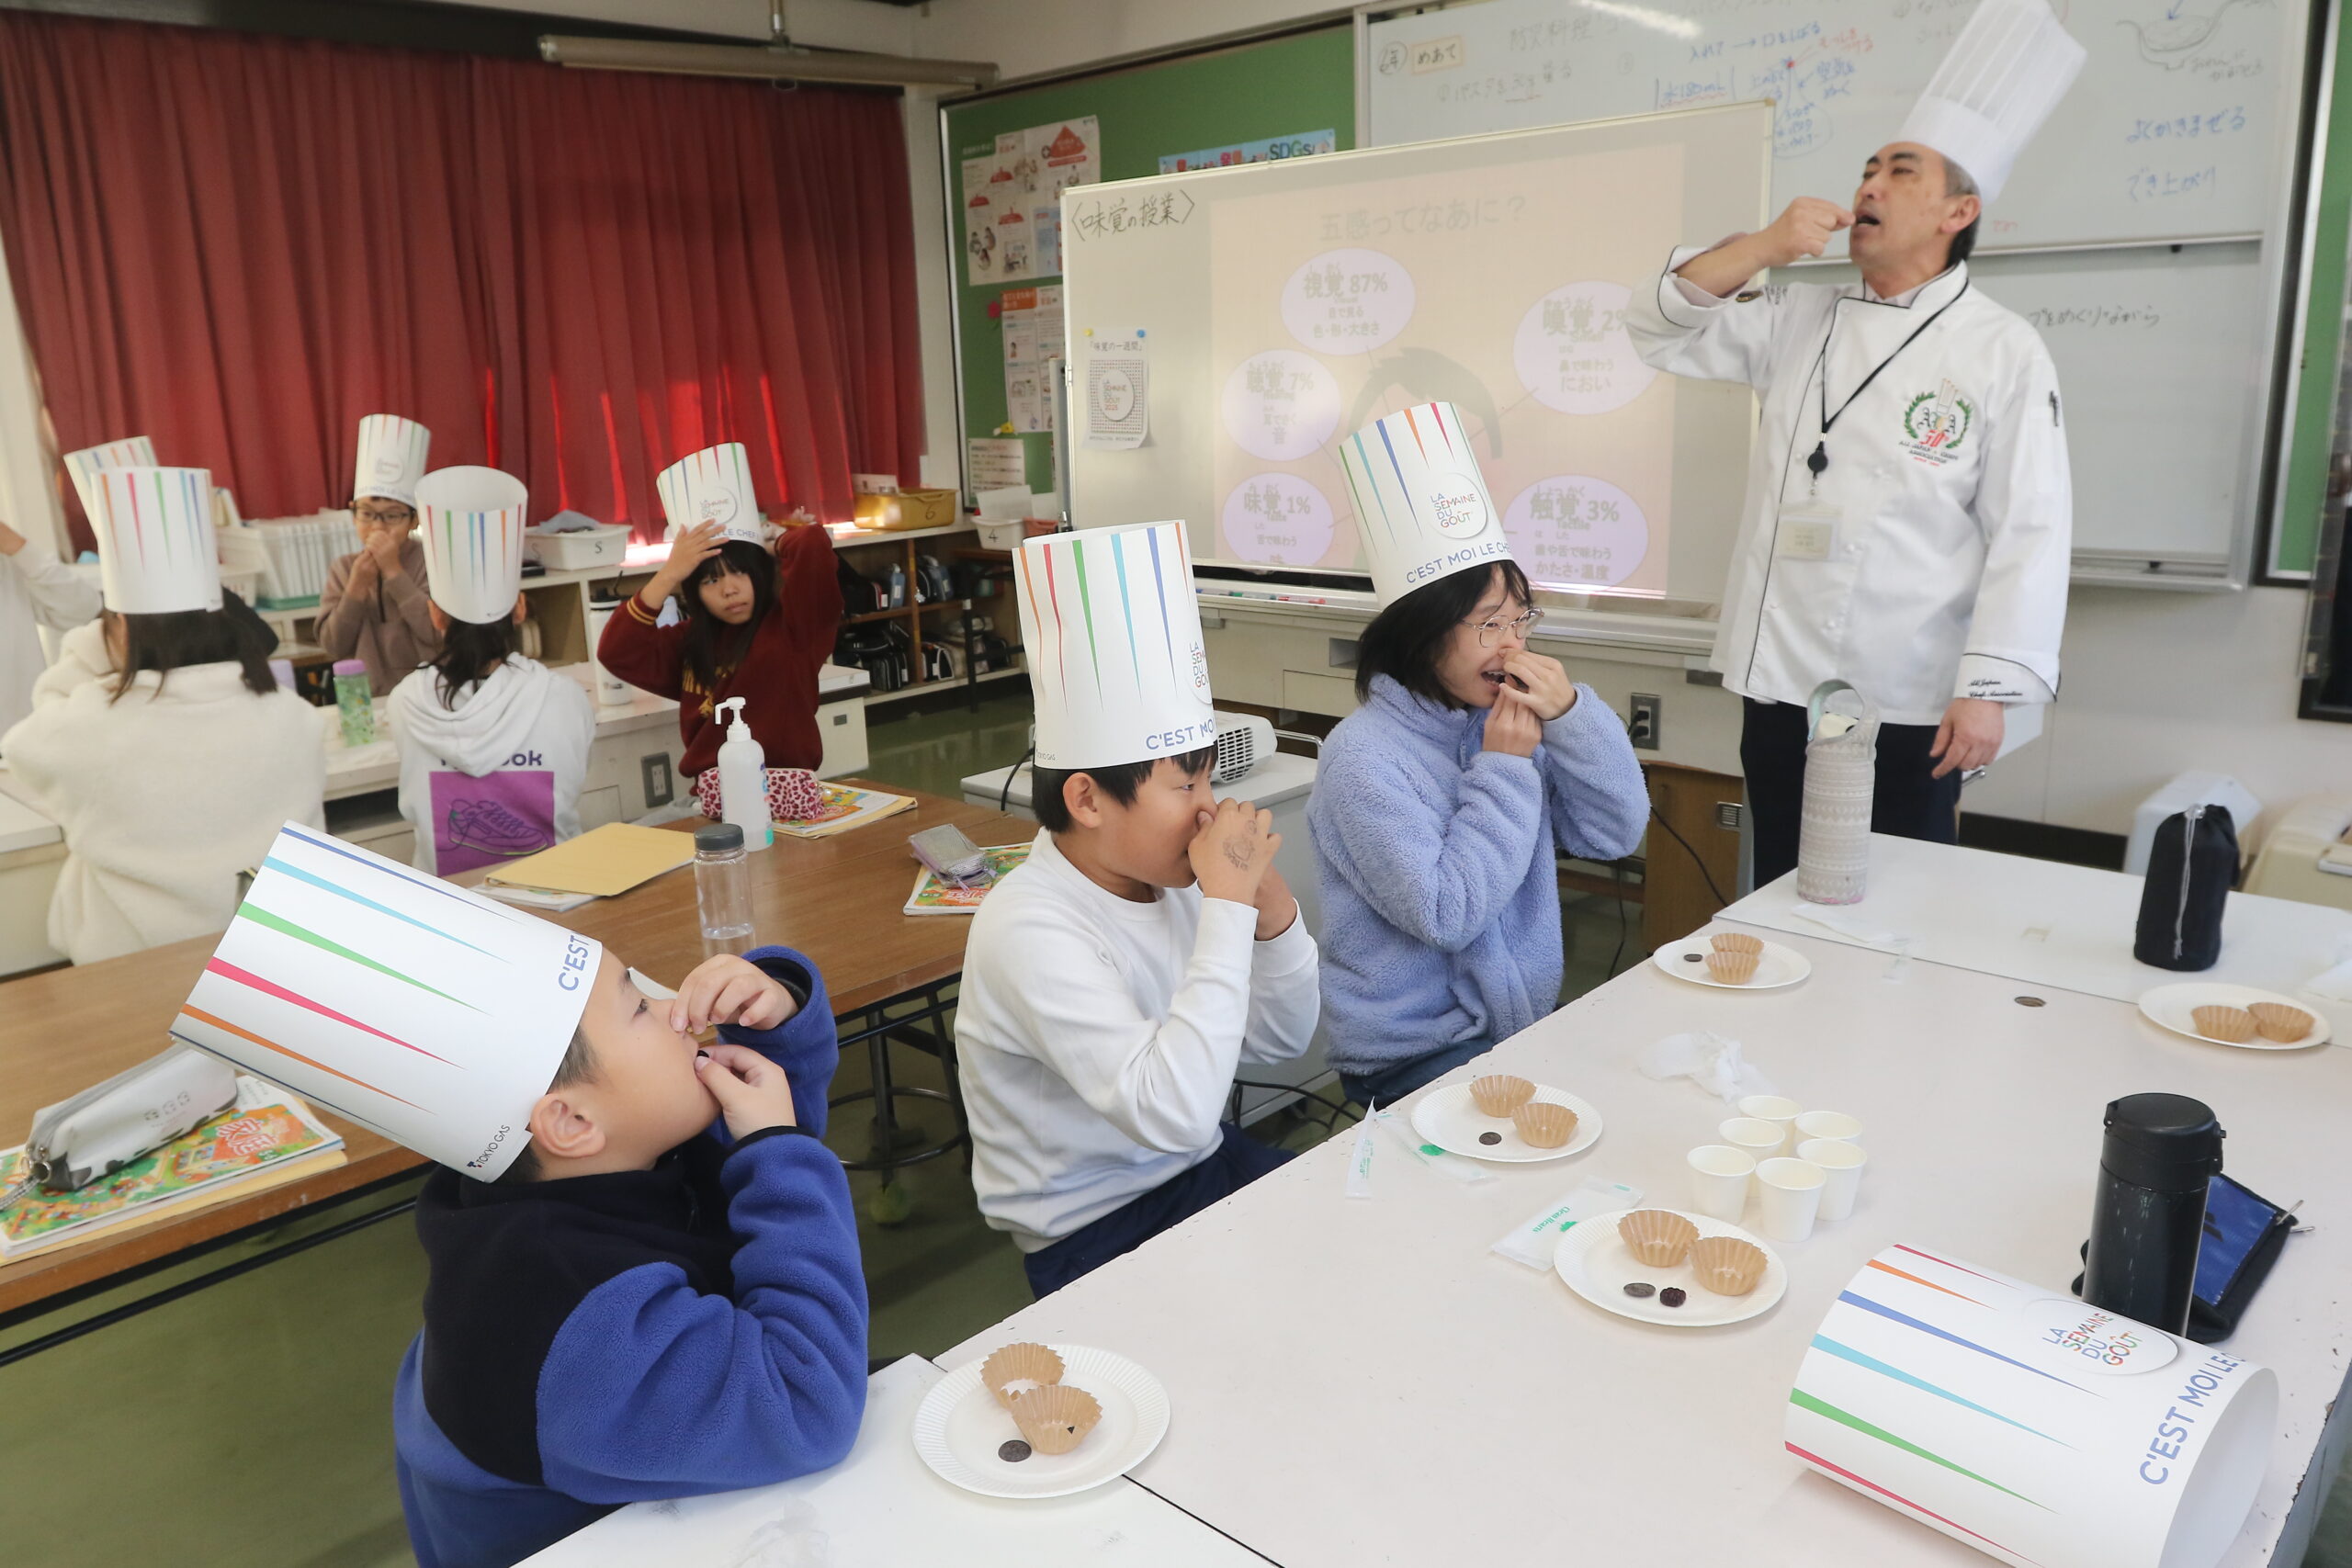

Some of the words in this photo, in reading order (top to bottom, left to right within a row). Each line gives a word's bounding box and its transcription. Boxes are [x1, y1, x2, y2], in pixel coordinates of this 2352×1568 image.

[1417, 42, 1457, 65] めあて
[1349, 272, 1388, 295] 87%
[1287, 495, 1311, 514] 1%
[1430, 492, 1445, 503] LA
[1434, 493, 1477, 513] SEMAINE
[925, 510, 935, 521] 6
[1436, 509, 1453, 521] DU
[1588, 500, 1620, 522] 3%
[988, 528, 999, 543] 4
[1406, 558, 1443, 584] C'EST
[1447, 546, 1477, 567] MOI
[1479, 543, 1496, 557] LE
[1146, 726, 1194, 750] C'EST
[558, 934, 590, 992] C'EST
[476, 1141, 499, 1166] TOKYO
[496, 1124, 511, 1143] GAS
[2041, 1327, 2069, 1345] LA
[2062, 1313, 2115, 1351] SEMAINE
[2081, 1338, 2108, 1359] DU
[2139, 1405, 2195, 1485] C'EST
[2177, 1369, 2223, 1407] MOI
[2204, 1355, 2239, 1373] LE
